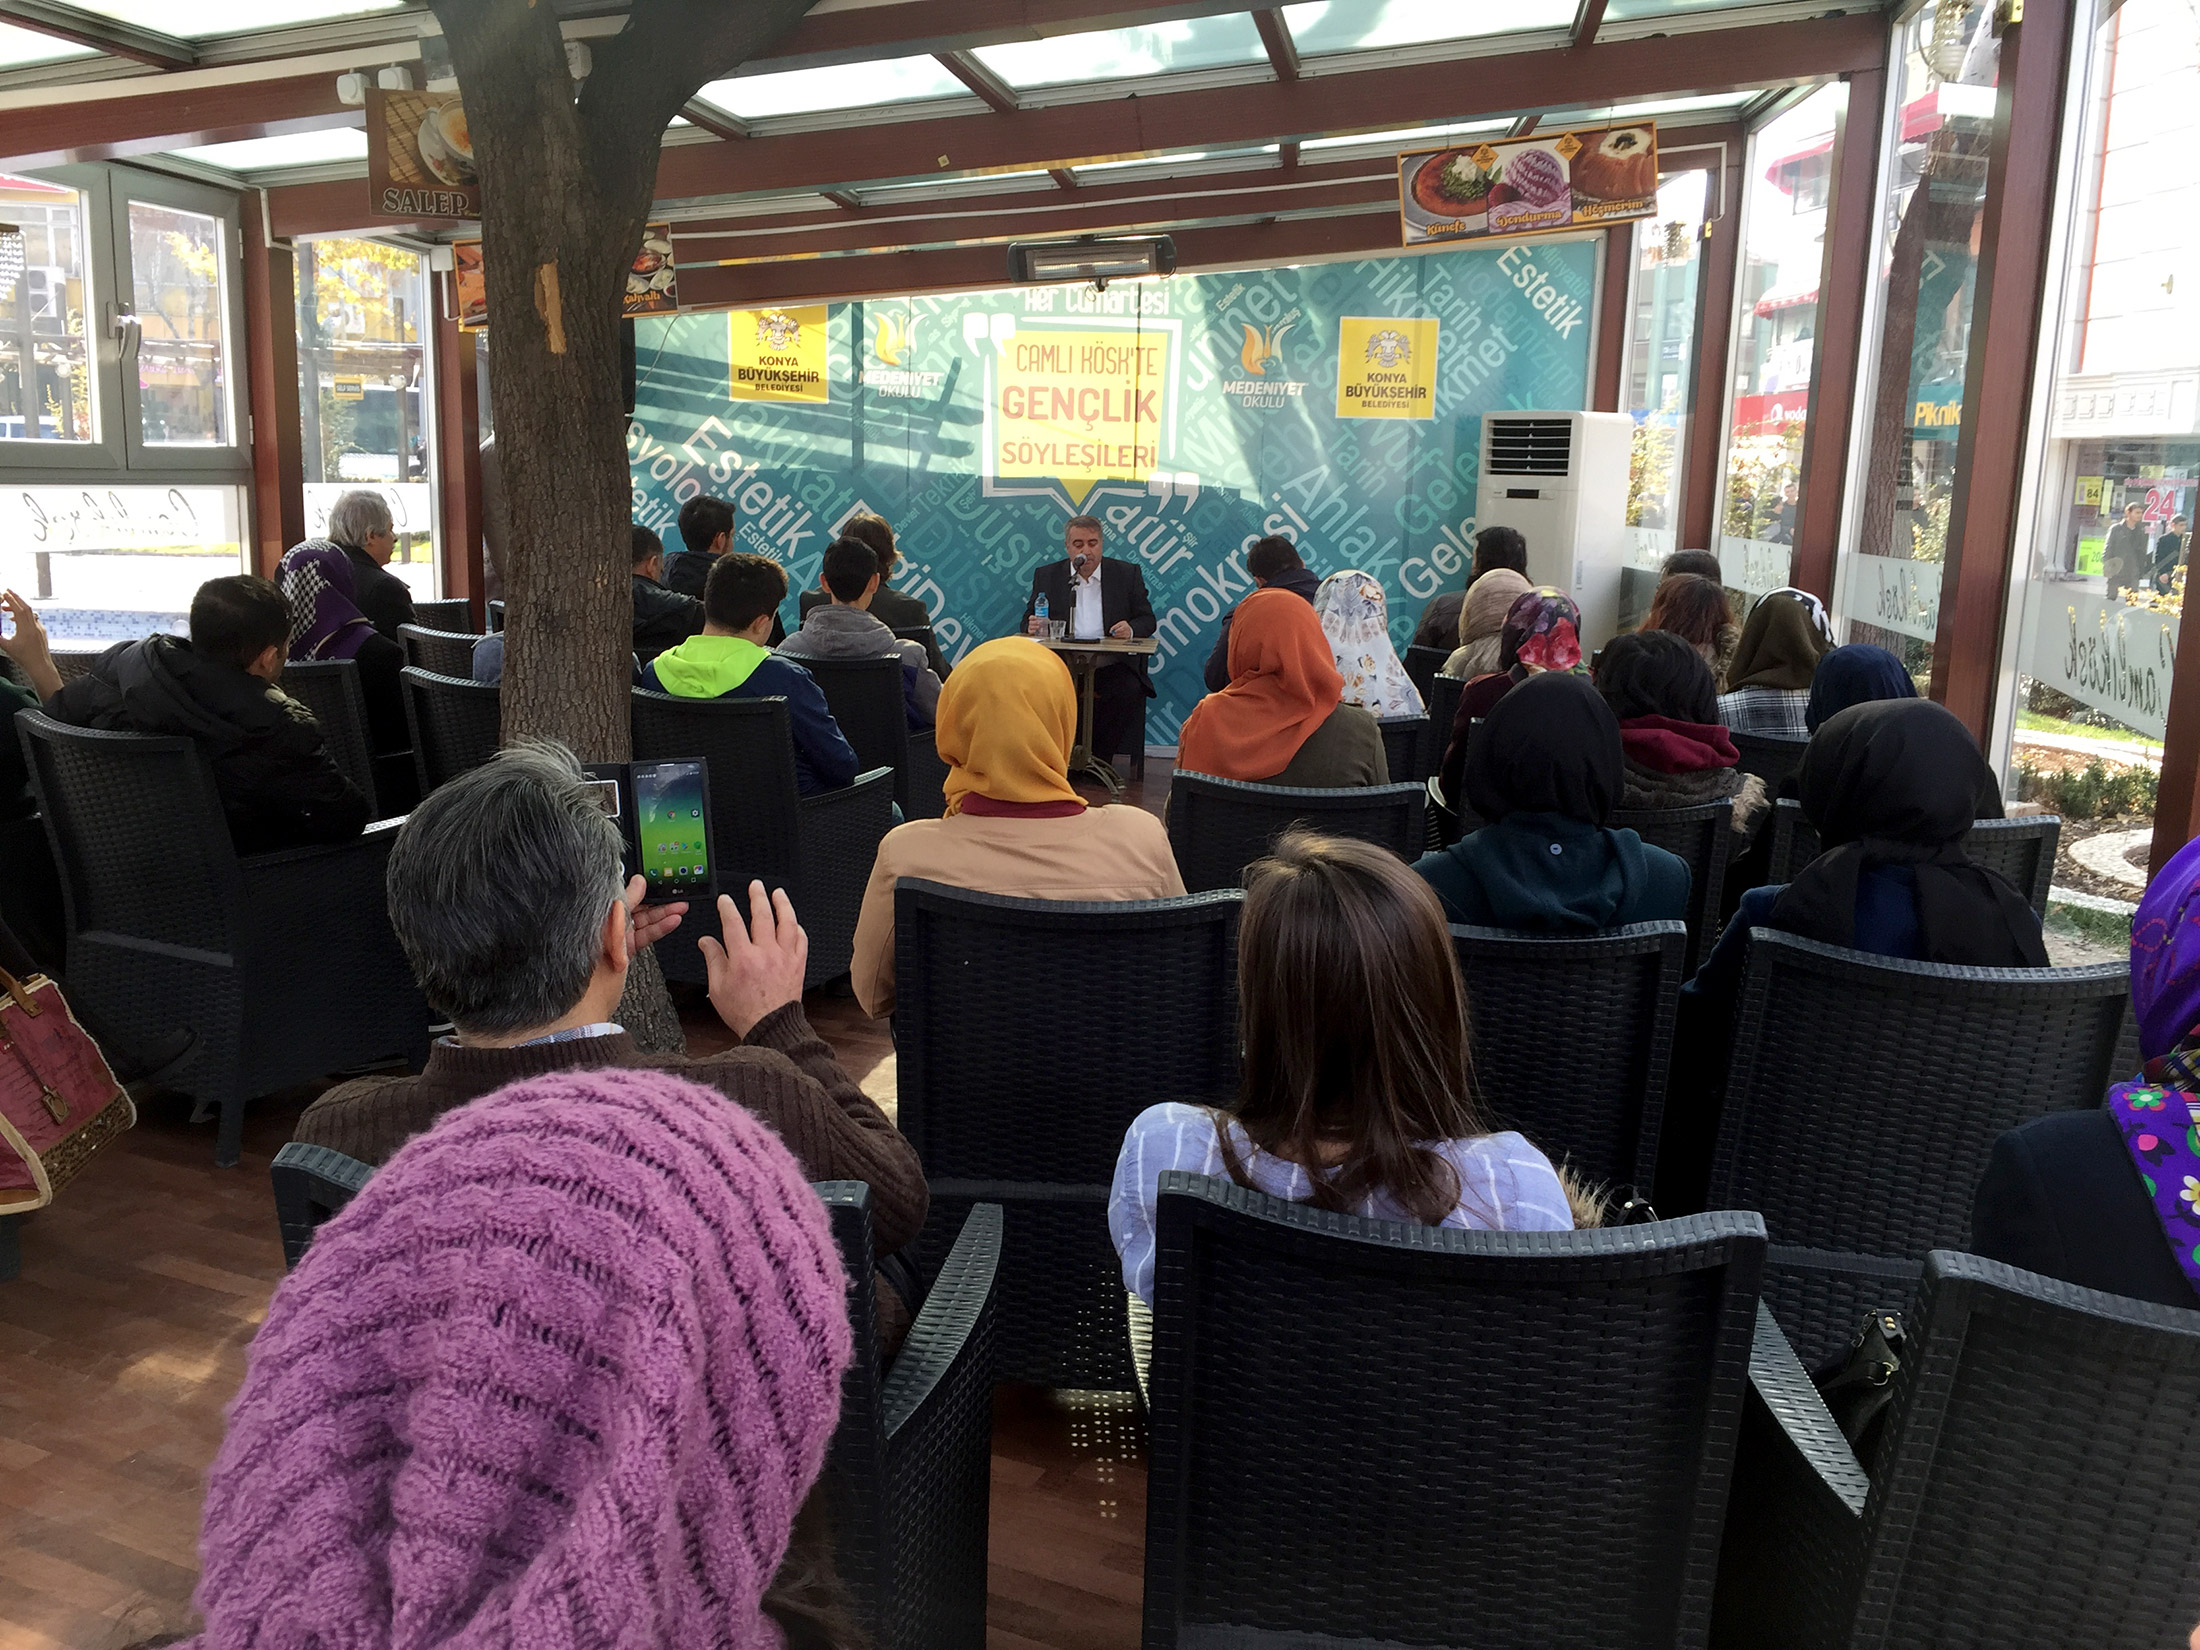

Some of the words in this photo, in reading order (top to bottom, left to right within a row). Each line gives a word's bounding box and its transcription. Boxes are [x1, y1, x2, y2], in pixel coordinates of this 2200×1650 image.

[382, 187, 469, 216] SALEP
[1426, 220, 1466, 236] Künefe
[1496, 209, 1562, 226] Dondurma
[1421, 261, 1483, 341] Tarih
[1495, 244, 1584, 341] Estetik
[758, 356, 799, 367] KONYA
[737, 367, 820, 383] BÜYÜKŞEHİR
[1366, 372, 1408, 384] KONYA
[754, 382, 804, 393] BELEDİYESİ
[878, 386, 922, 399] OKULU
[1345, 383, 1427, 400] BÜYÜKŞEHİR
[1002, 380, 1158, 432] GENÇLİK
[1242, 396, 1286, 410] OKULU
[1361, 399, 1410, 410] BELEDİYESİ
[1913, 400, 1962, 427] Piknik
[1002, 436, 1156, 473] SÖYLEŞİLERİ
[1327, 424, 1388, 499] Tarih
[681, 414, 817, 560] Estetik
[911, 457, 976, 513] Teknik
[2086, 488, 2099, 499] 84
[2143, 487, 2176, 522] 24
[1281, 463, 1403, 582] Ahlak
